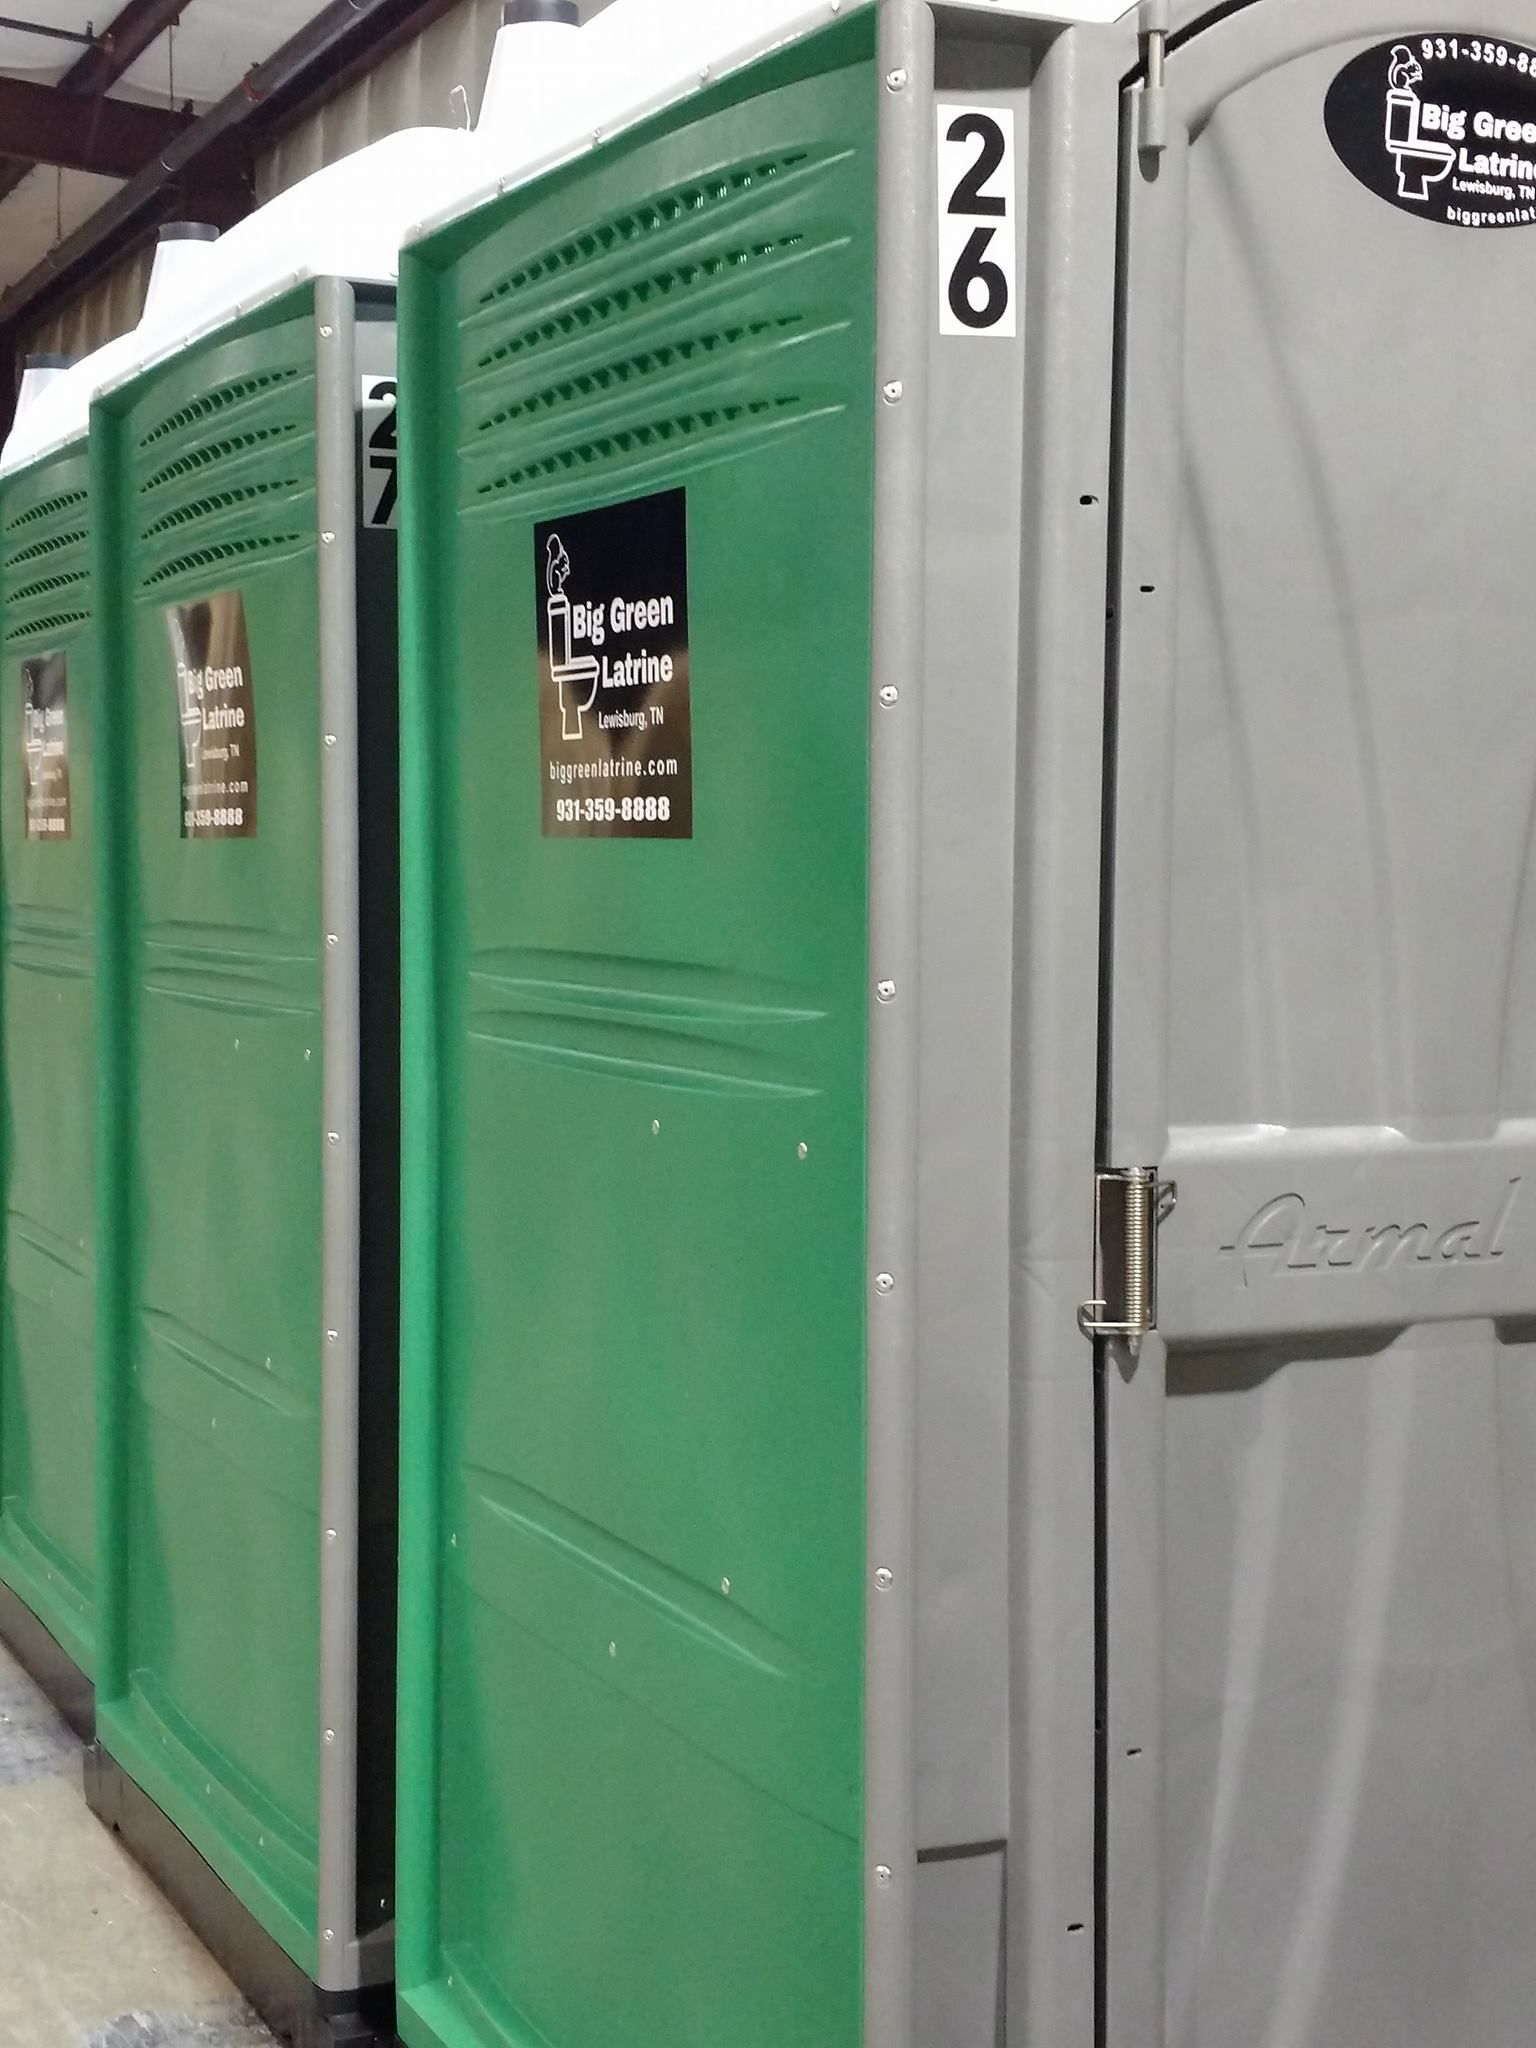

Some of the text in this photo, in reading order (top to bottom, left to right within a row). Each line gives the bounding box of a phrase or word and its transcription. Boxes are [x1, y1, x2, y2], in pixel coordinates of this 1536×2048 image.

[1421, 102, 1467, 141] Big
[1458, 147, 1536, 181] Latrin
[1452, 176, 1536, 201] Lewisburg, TN
[946, 113, 1008, 329] 26
[573, 595, 674, 646] Big Green
[205, 665, 243, 691] Green
[602, 648, 673, 688] Latrine
[202, 702, 245, 730] Latrine
[598, 705, 664, 731] Lewisburg, TN
[549, 756, 678, 784] biggreenlatrine.com
[556, 796, 671, 822] 931-359-8888
[1219, 1176, 1522, 1286] Armal
